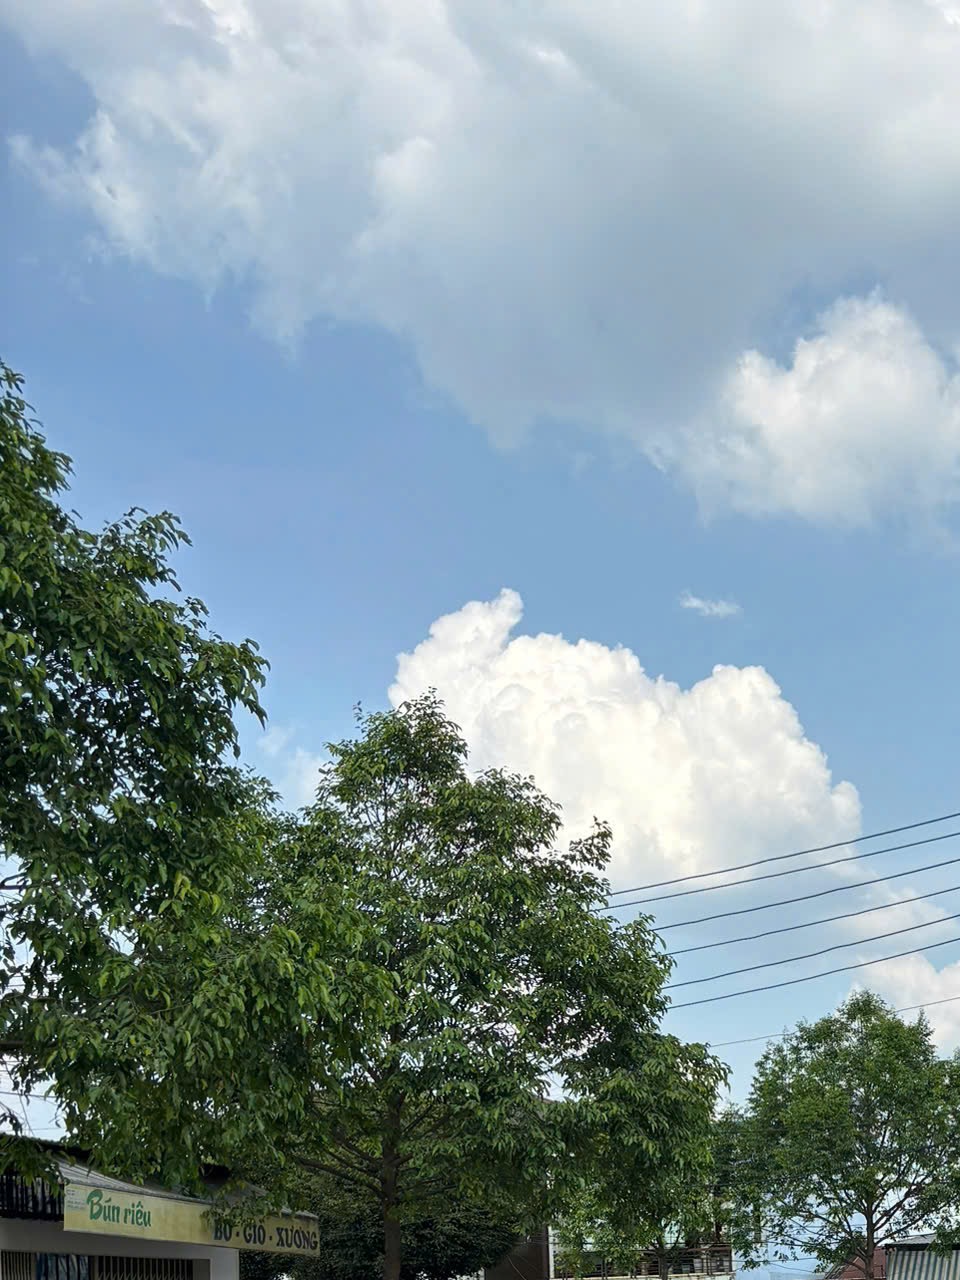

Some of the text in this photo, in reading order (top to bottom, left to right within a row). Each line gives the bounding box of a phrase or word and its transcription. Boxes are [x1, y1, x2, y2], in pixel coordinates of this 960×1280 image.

[86, 1189, 120, 1224] Bún
[123, 1201, 152, 1227] riêu
[276, 1226, 318, 1251] XƯƠNG
